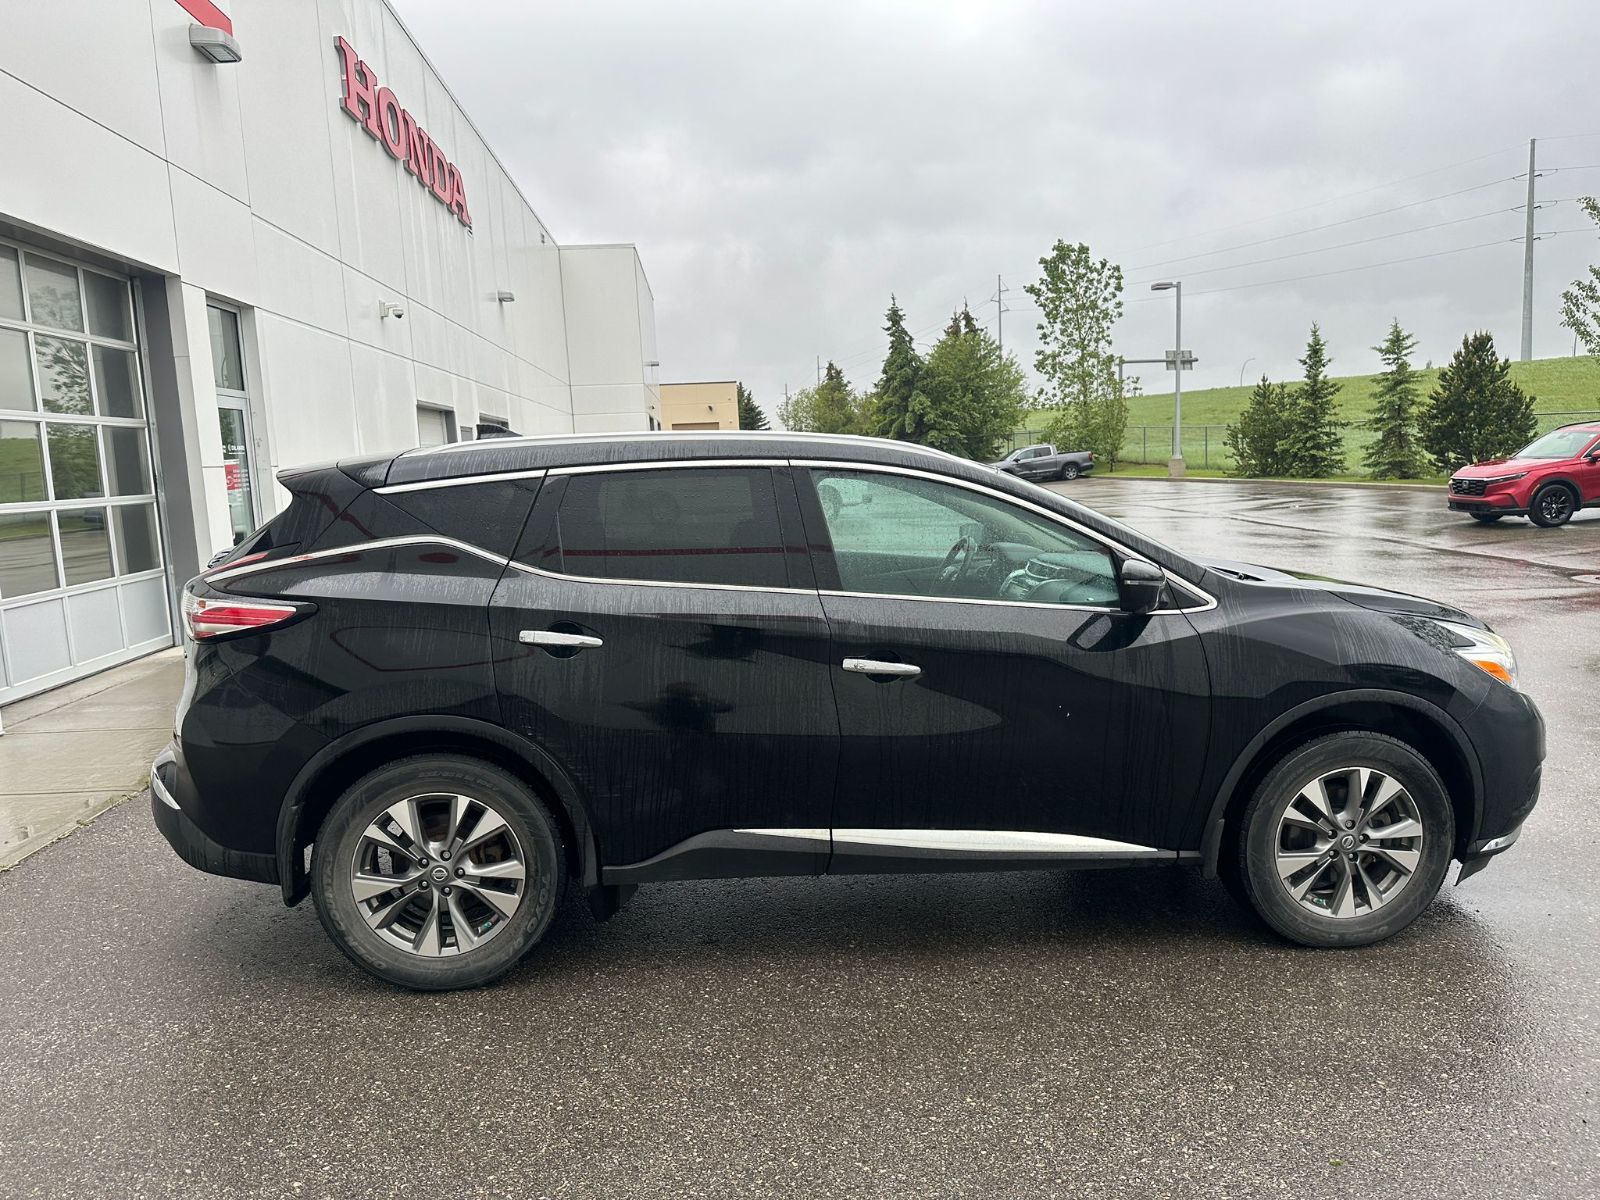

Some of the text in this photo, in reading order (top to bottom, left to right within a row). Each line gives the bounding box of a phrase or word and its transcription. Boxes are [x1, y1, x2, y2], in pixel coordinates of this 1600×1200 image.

[333, 35, 472, 227] HONDA
[526, 872, 551, 933] TOYO
[345, 936, 386, 970] OPEN
